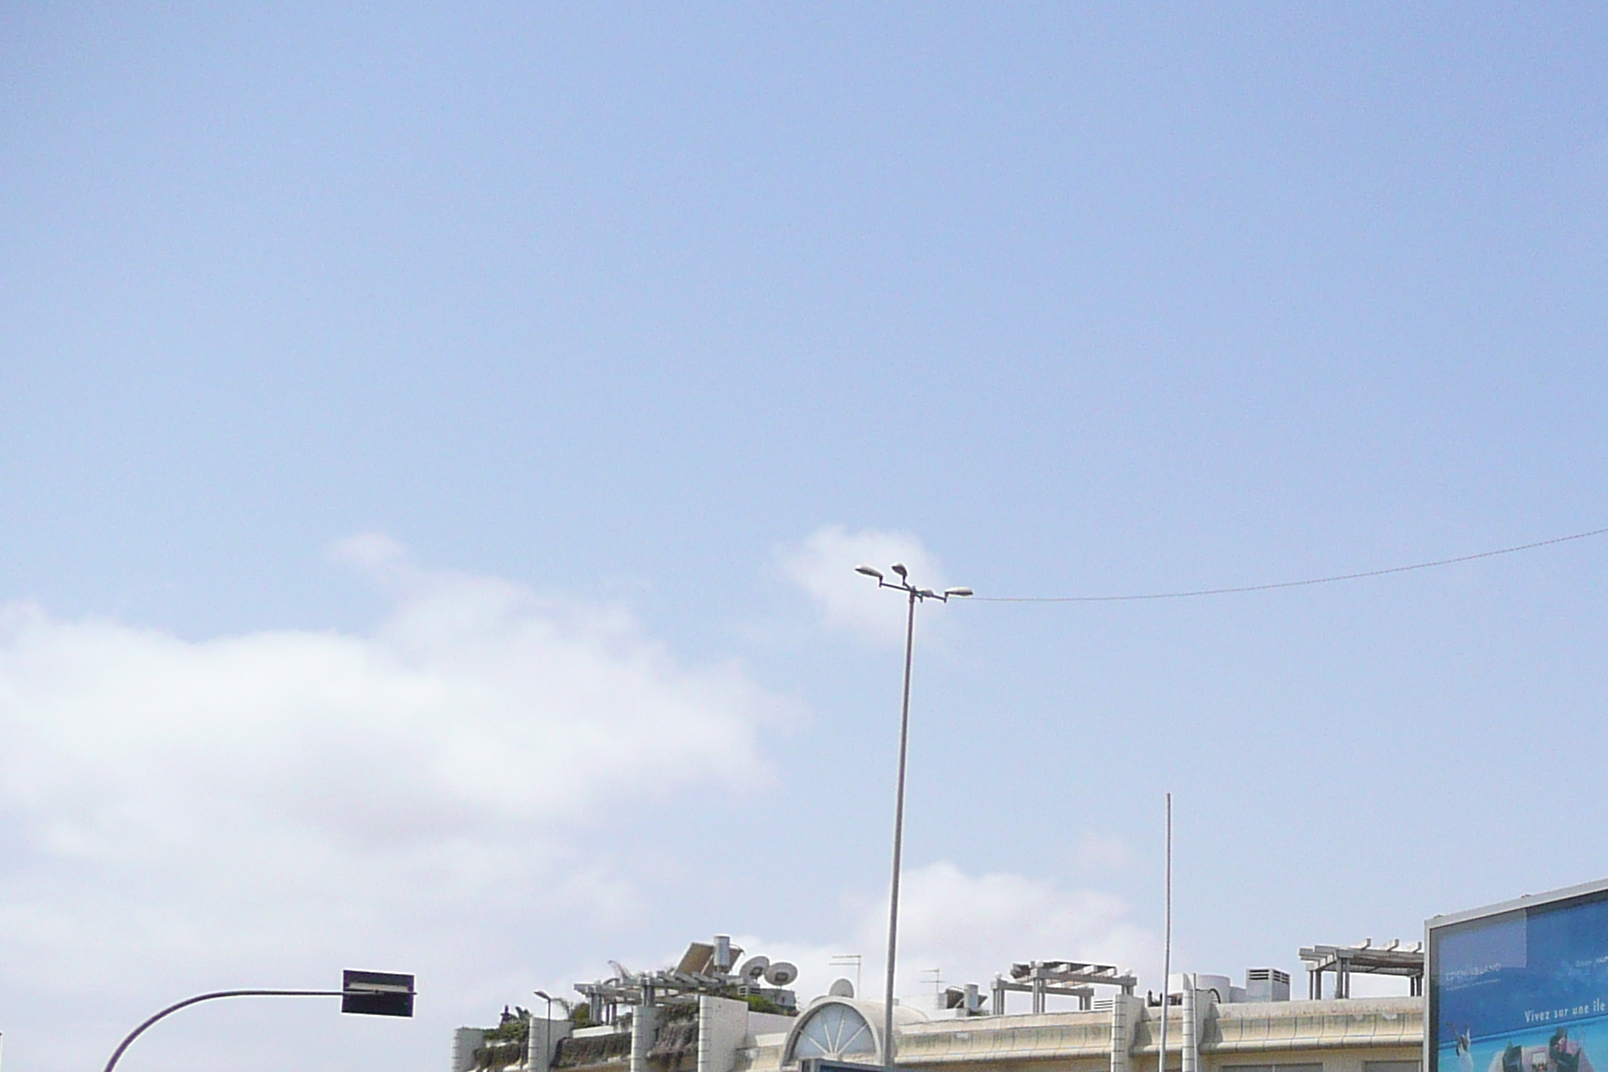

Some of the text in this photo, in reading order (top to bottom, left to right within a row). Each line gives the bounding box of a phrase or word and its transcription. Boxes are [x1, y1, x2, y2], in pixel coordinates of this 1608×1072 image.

[1525, 1009, 1550, 1023] Vivez
[1554, 1008, 1569, 1019] sur
[1572, 1004, 1589, 1015] une
